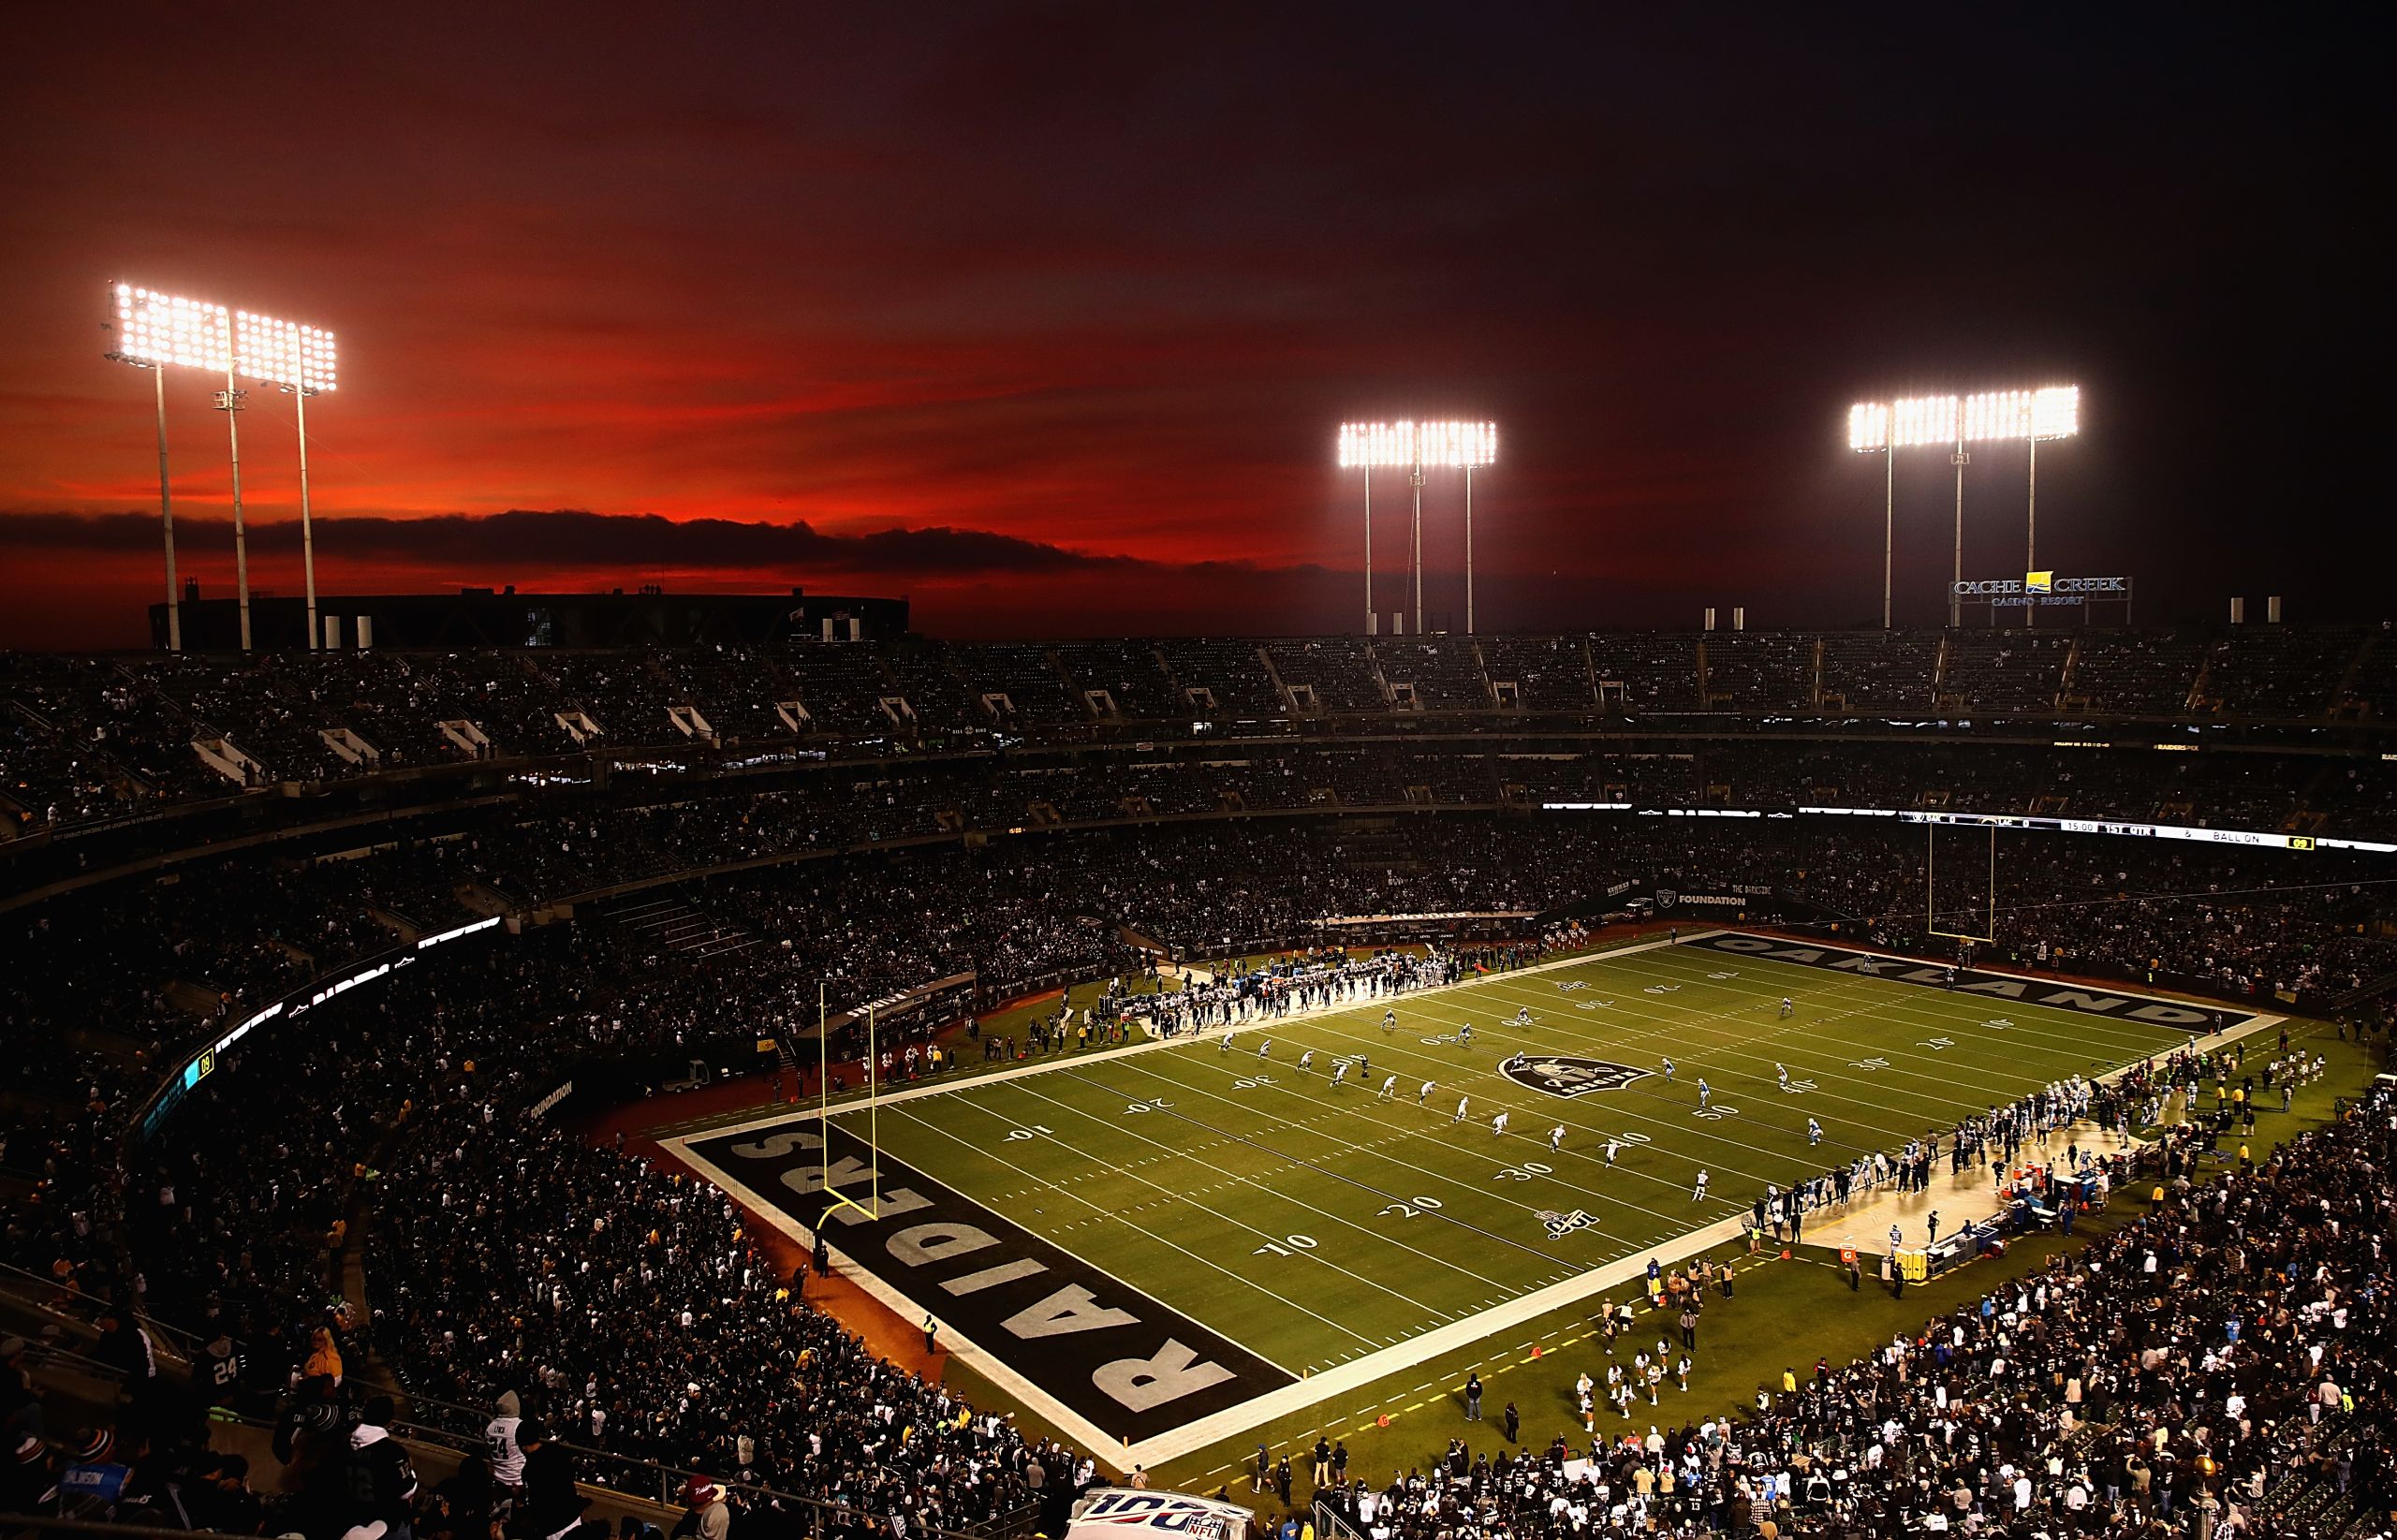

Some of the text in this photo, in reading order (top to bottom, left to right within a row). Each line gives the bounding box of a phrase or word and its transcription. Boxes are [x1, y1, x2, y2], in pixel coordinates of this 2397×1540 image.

[1954, 578, 2125, 594] CACHE CREEK
[1992, 596, 2085, 606] CASINO RESORT
[2068, 822, 2094, 831] 15:00
[2105, 824, 2151, 836] 1ST QTR
[2184, 829, 2259, 843] & BALL ON
[2293, 838, 2307, 848] 09
[1732, 884, 1743, 893] THE
[1679, 895, 1746, 906] FOUNDATION
[1713, 939, 2208, 1023] OAKLAND
[1979, 1019, 2014, 1030] 10
[1916, 1037, 1955, 1050] 20
[201, 1056, 210, 1073] 09
[1847, 1058, 1890, 1071] 30
[1238, 1075, 1280, 1089] 30
[1561, 1071, 1639, 1094] RAIDERS
[1780, 1080, 1818, 1093] 40
[531, 1079, 572, 1120] FOUNDATION
[1127, 1097, 1175, 1113] 20
[1691, 1105, 1740, 1121] 50
[1009, 1124, 1054, 1140] 10
[1501, 1162, 1553, 1181] 30
[1386, 1195, 1443, 1218] 20
[1267, 1234, 1318, 1257] 10
[1844, 1251, 1852, 1259] G
[731, 1132, 1237, 1413] RAIDERS
[213, 1357, 238, 1386] 24
[490, 1437, 508, 1459] 24
[695, 1483, 713, 1495] Raiders
[1504, 1484, 1512, 1492] 12
[1515, 1477, 1525, 1487] 55
[1552, 1478, 1563, 1487] 34
[1188, 1523, 1214, 1540] NFL
